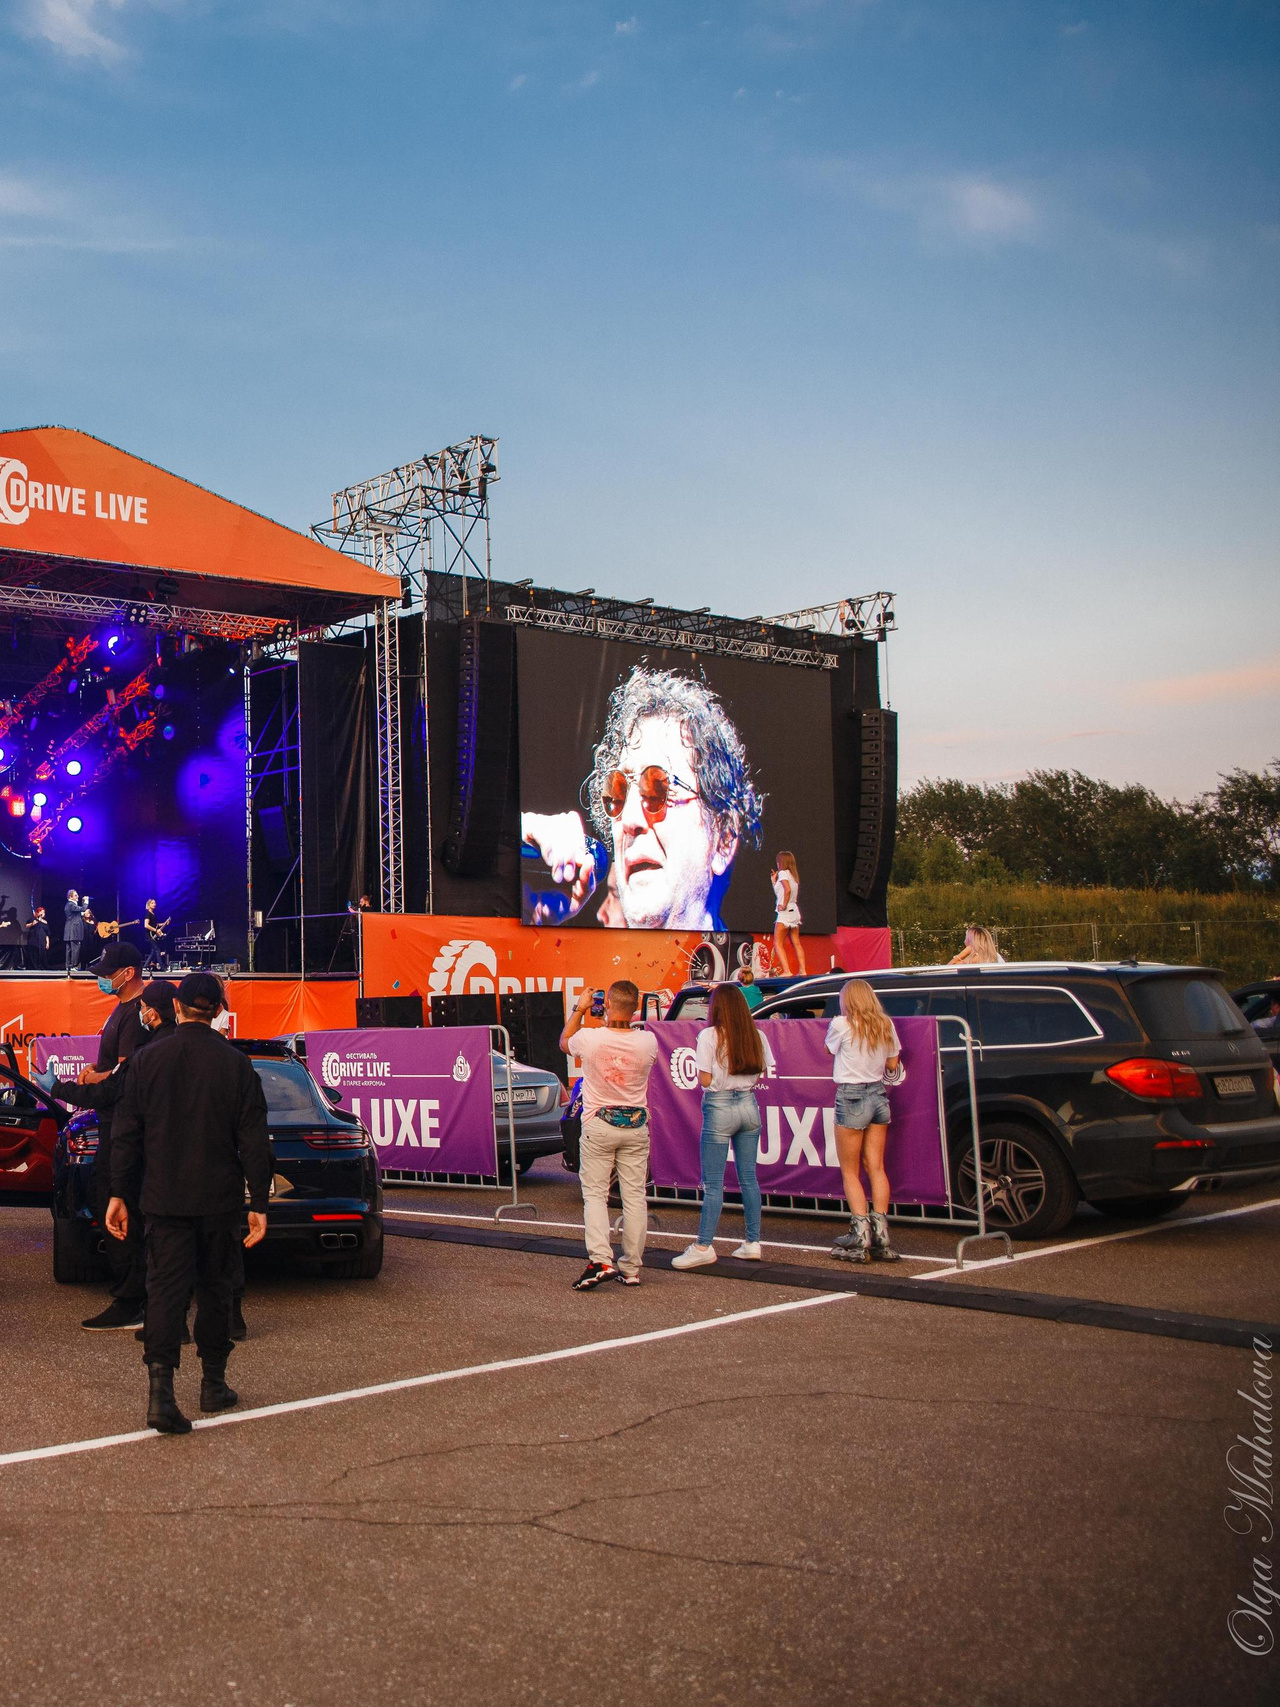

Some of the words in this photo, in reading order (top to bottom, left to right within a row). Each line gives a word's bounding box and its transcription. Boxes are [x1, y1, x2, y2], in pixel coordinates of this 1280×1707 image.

[9, 477, 86, 516] DRIVE
[95, 490, 148, 524] LIVE
[53, 1063, 75, 1076] DRIVE
[332, 1062, 364, 1077] DRIVE
[366, 1062, 391, 1077] LIVE
